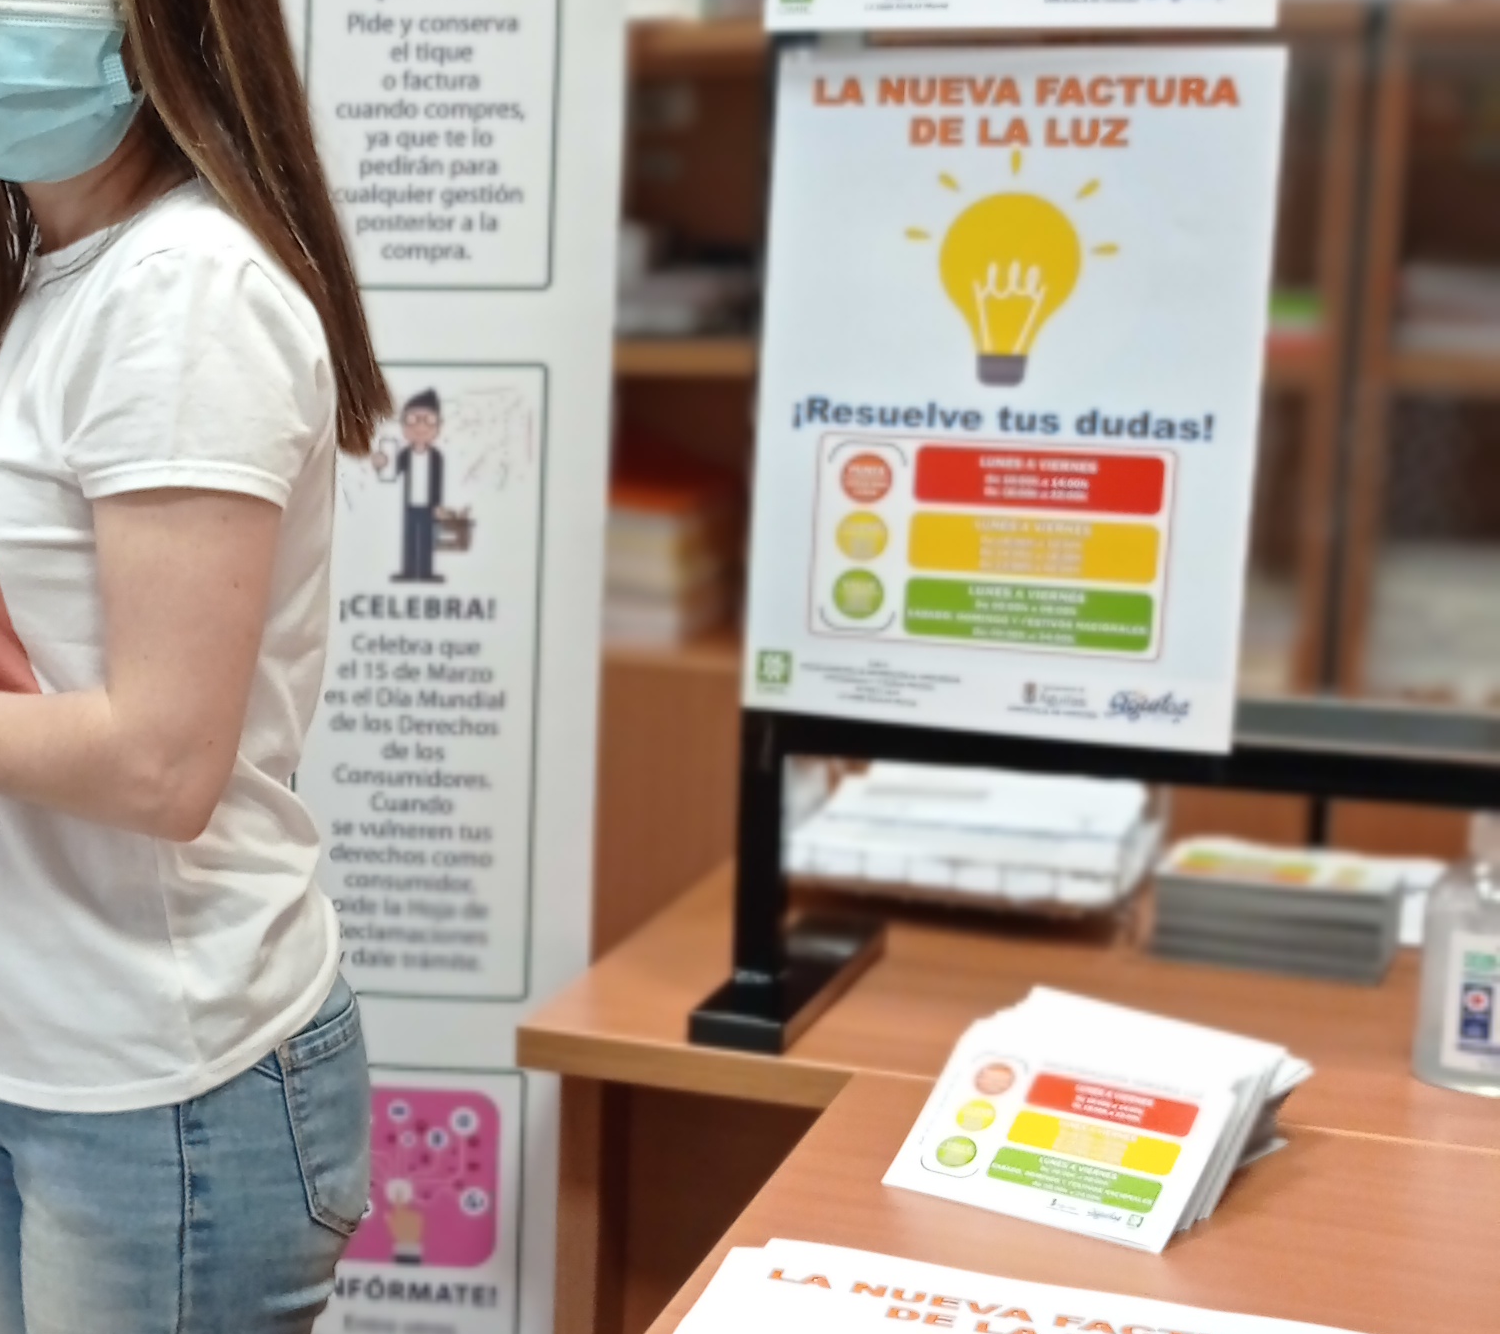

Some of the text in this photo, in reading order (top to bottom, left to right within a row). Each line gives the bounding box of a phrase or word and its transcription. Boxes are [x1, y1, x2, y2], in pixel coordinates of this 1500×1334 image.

[347, 13, 520, 38] Pide y conserva
[390, 41, 474, 66] el tique
[381, 70, 481, 91] o factura
[815, 75, 1239, 107] LA NUEVA FACTURA
[335, 99, 525, 123] cuando compres,
[366, 127, 494, 151] ya que te lo
[910, 117, 1129, 147] DE LA LUZ
[359, 155, 499, 180] pedirán para
[330, 181, 524, 212] cualquier gestión
[355, 212, 499, 236] posterior a la
[381, 244, 471, 264] compra.
[792, 396, 1214, 441] ¡Resuelve tus dudas!
[340, 594, 496, 622] ¡CELEBRA!
[352, 634, 481, 660] Celebra que
[338, 663, 494, 683] el 15 de Marzo
[324, 687, 506, 710] es el Día Mundial
[329, 713, 499, 736] de los Derechos
[381, 741, 445, 762] de los
[332, 763, 491, 789] Consumidores.
[370, 791, 454, 815] Cuando
[459, 825, 493, 842] tus
[334, 1274, 498, 1308] NFÓRMATE!
[769, 1269, 831, 1289] LA
[851, 1281, 1035, 1323] NUEVA
[886, 1306, 955, 1327] DE
